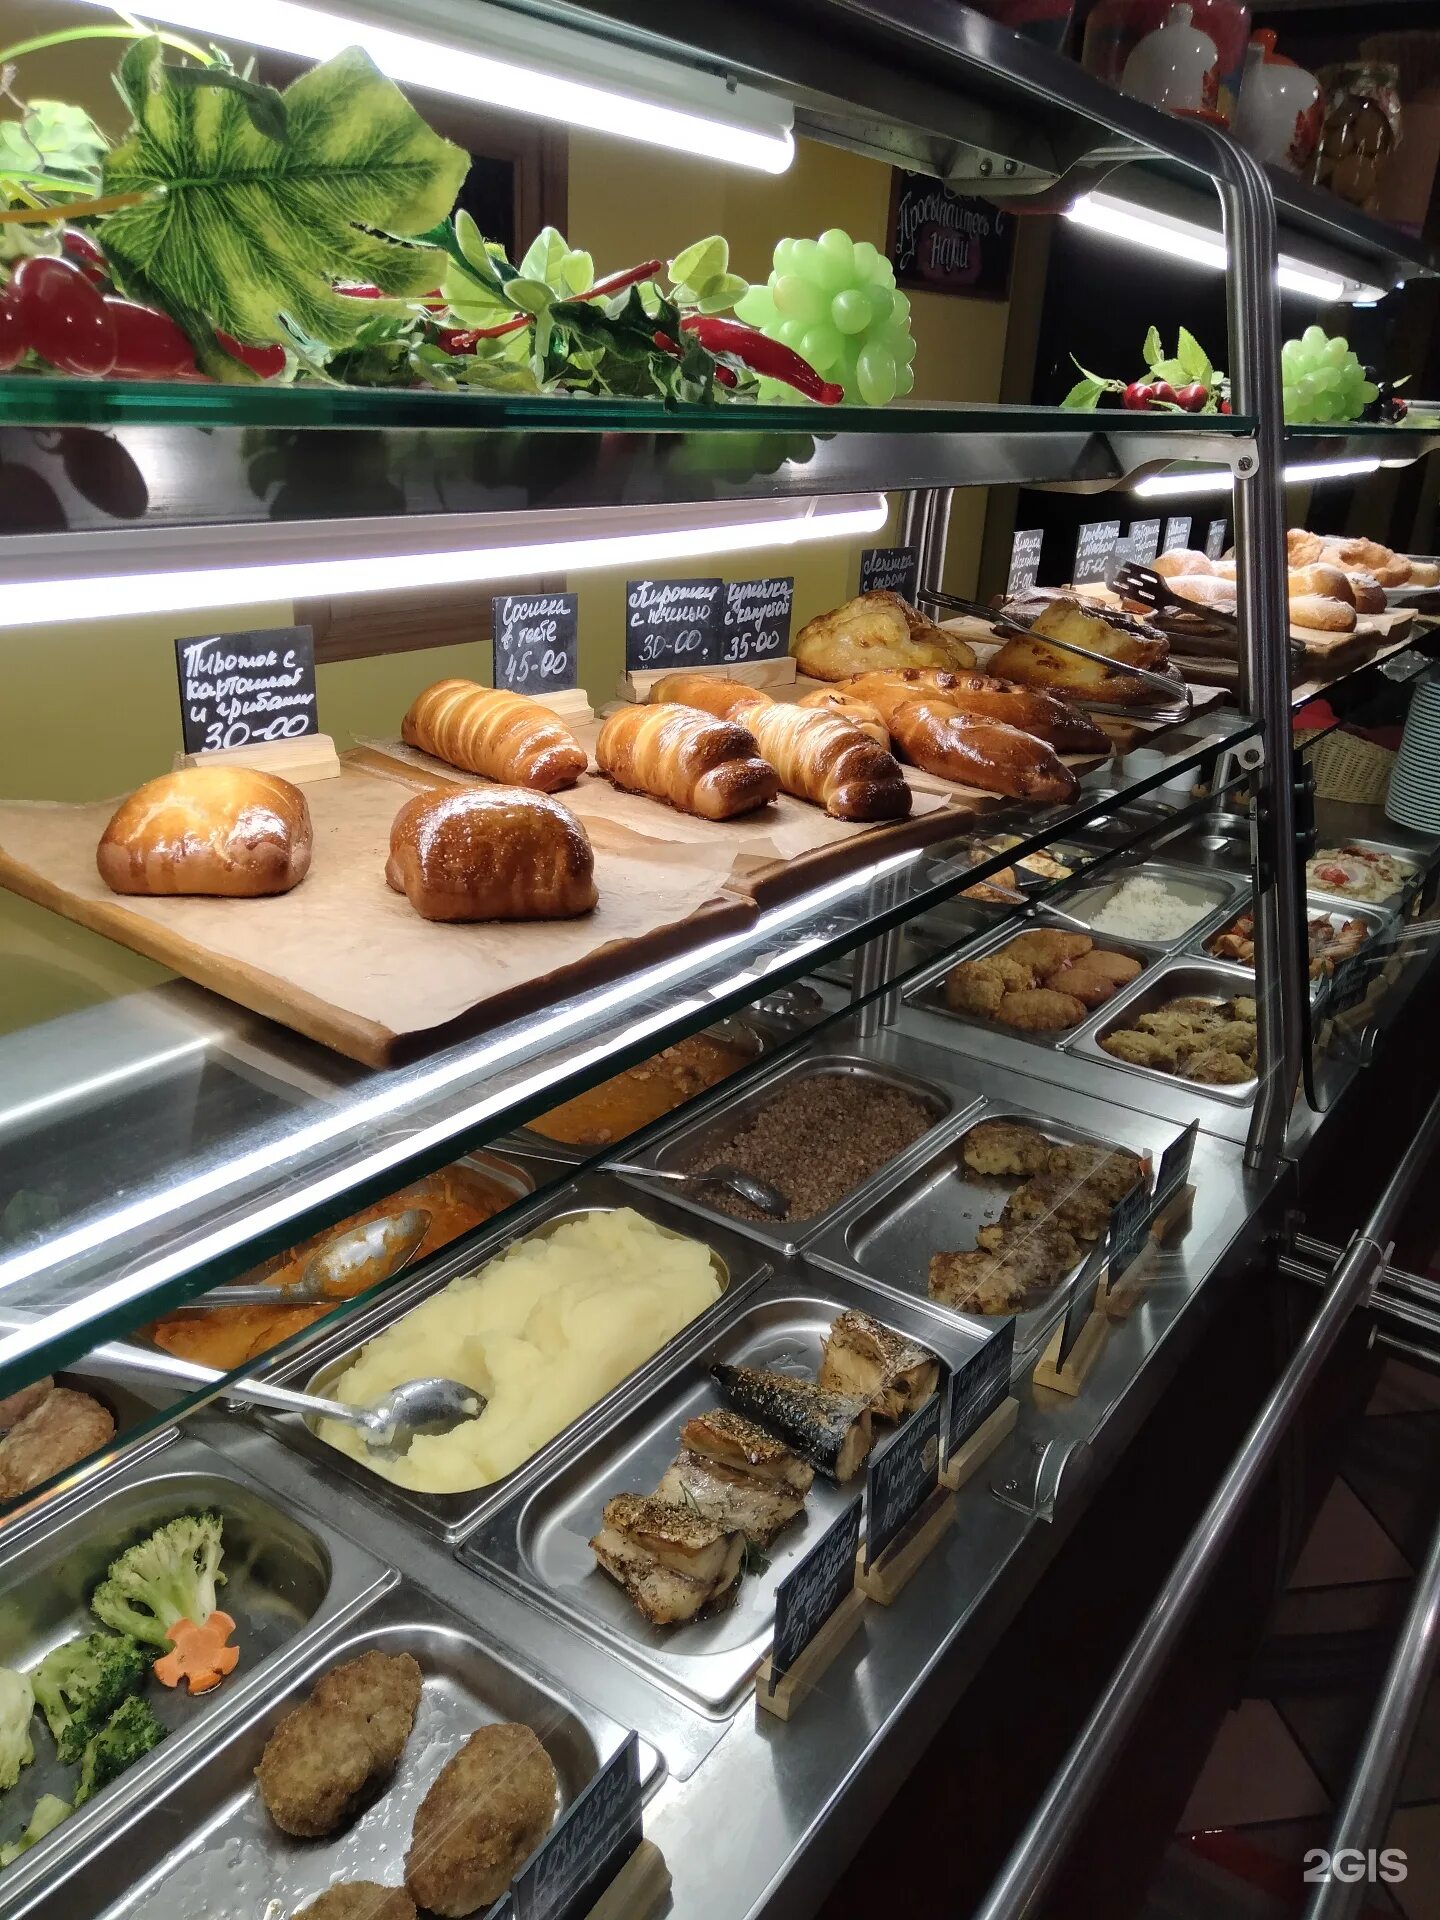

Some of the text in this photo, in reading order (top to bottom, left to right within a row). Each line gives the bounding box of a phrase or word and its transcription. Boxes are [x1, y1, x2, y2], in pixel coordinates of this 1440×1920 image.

[502, 597, 571, 626] Сосиска
[630, 604, 711, 627] с печенью
[724, 596, 790, 633] с капустой
[518, 619, 557, 648] тесте
[639, 630, 702, 661] 30-00
[184, 637, 296, 677] Пирожок с
[505, 649, 567, 683] 45-00
[190, 692, 315, 725] и грибами
[200, 714, 309, 752] 30-00
